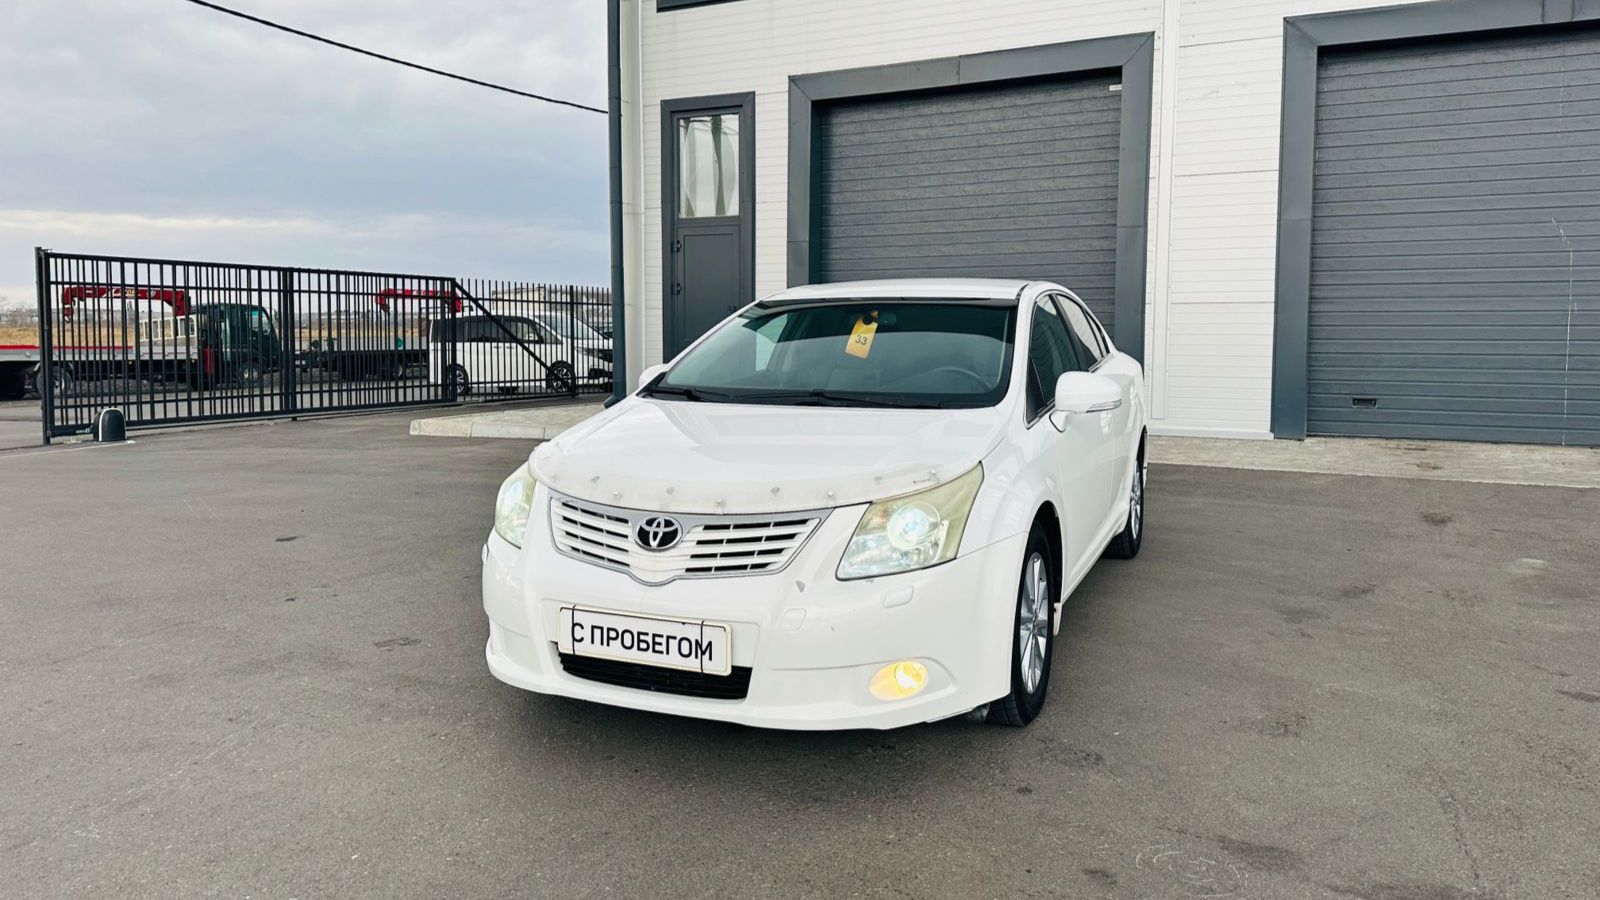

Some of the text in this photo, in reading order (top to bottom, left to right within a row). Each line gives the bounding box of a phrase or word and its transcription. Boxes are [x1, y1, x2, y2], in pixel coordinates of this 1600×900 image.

[855, 334, 868, 346] 33
[571, 622, 713, 662] С ПРОБЕГОМ
